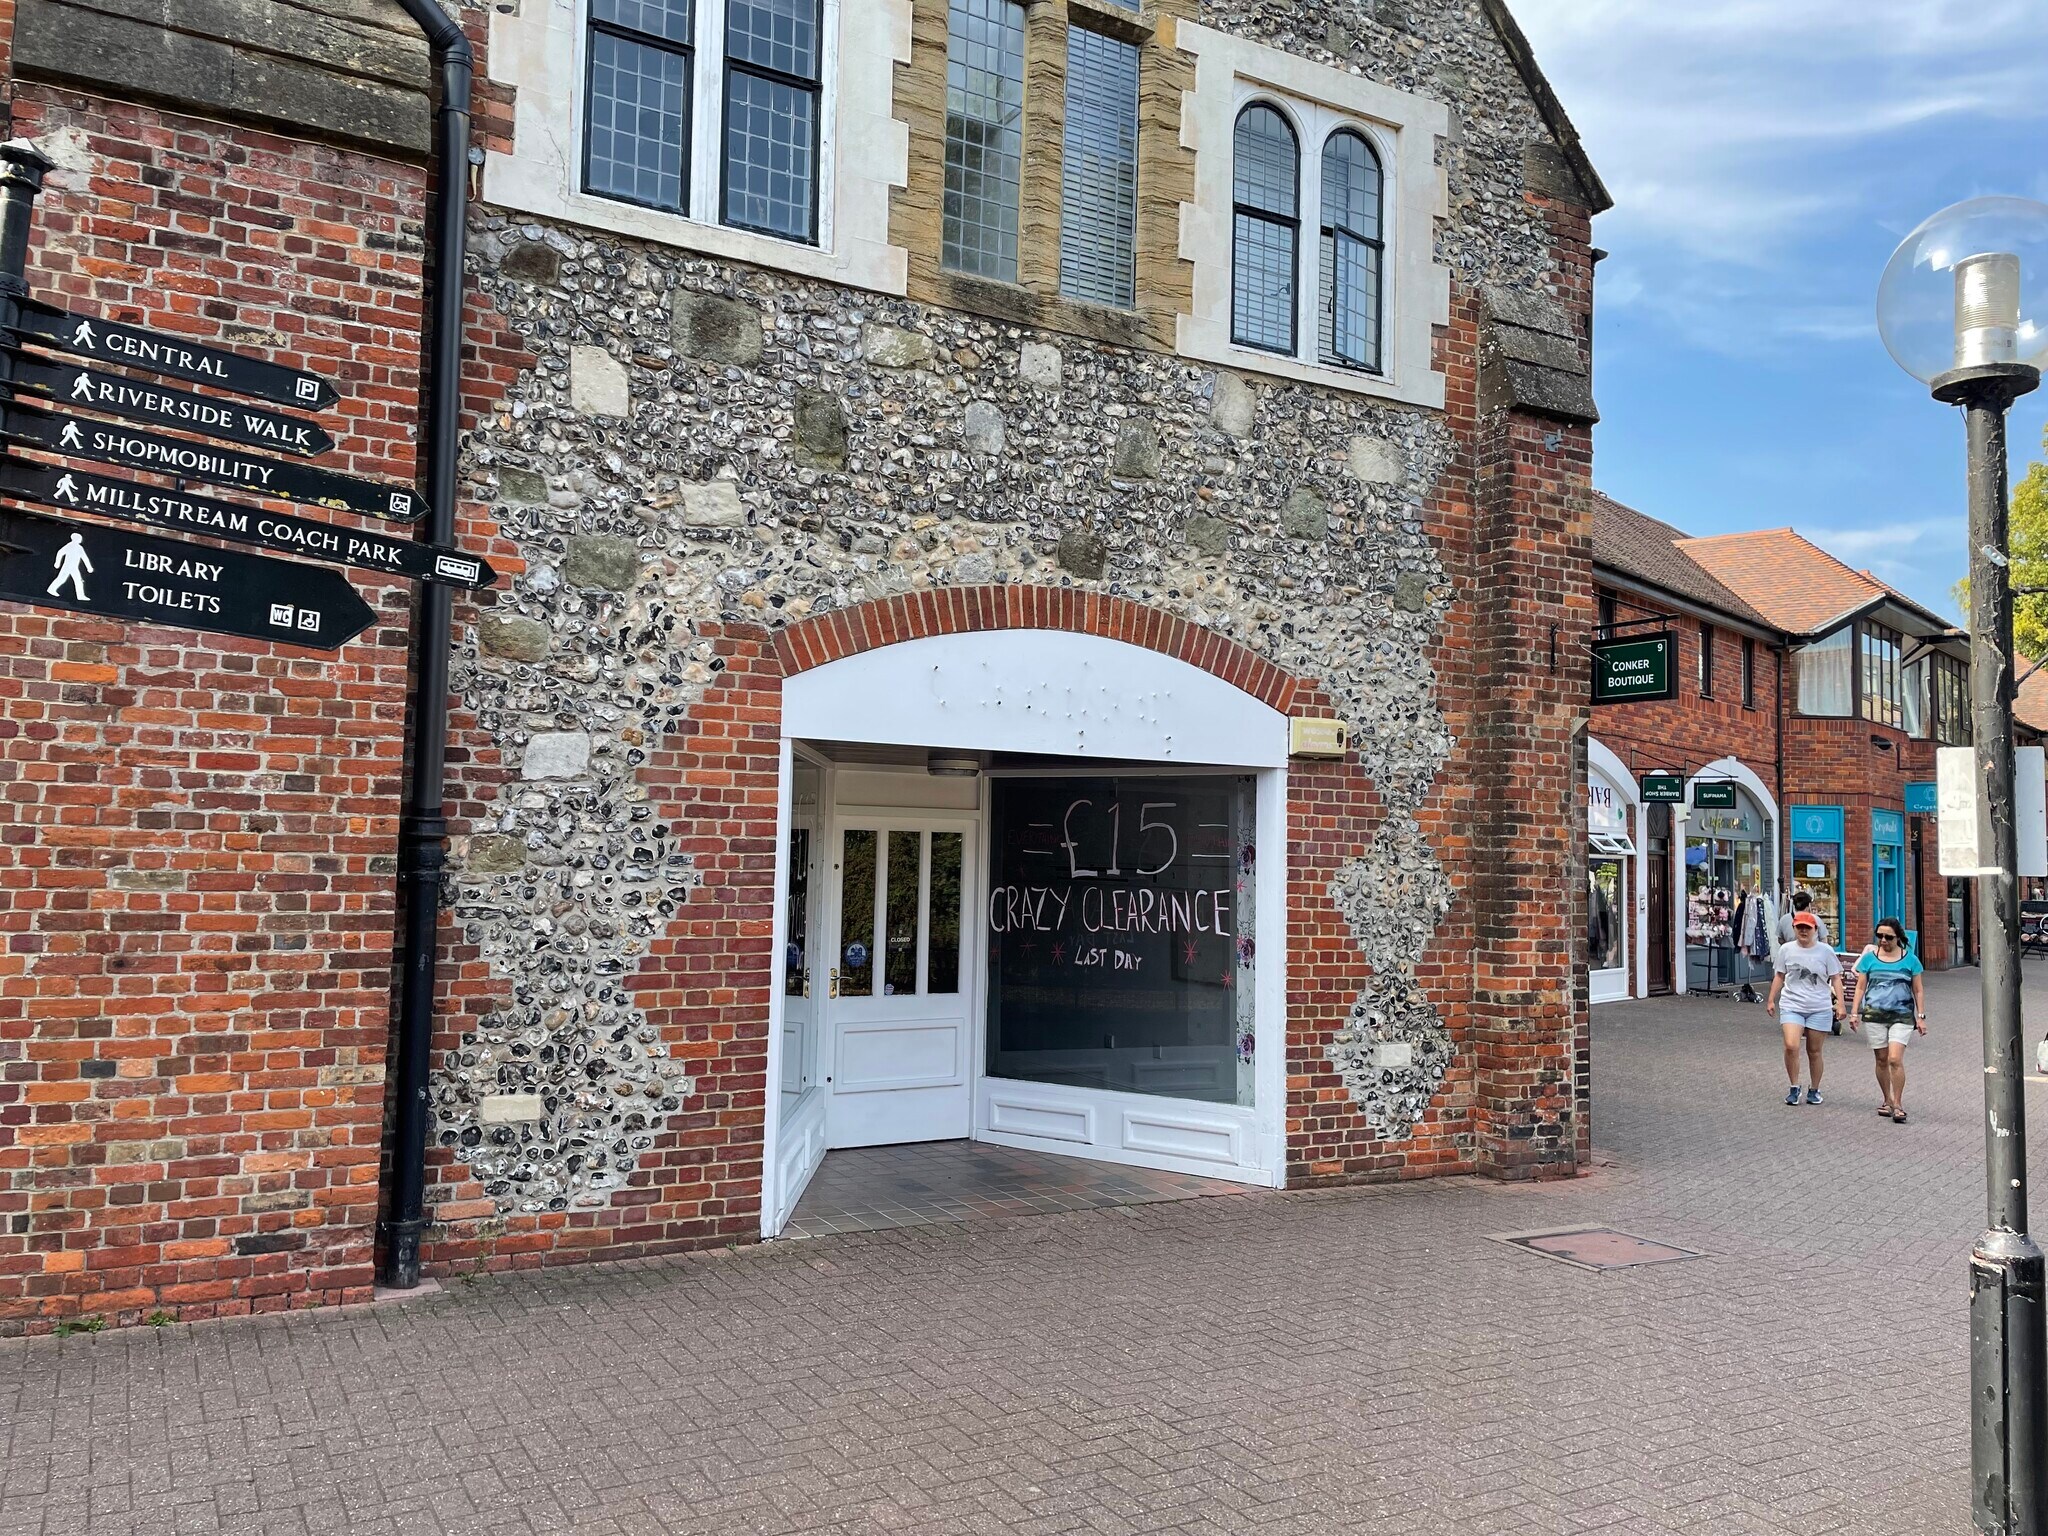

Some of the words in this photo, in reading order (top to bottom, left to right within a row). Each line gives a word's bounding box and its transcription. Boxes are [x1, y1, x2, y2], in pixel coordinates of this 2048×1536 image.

[105, 332, 229, 379] CENTRAL
[300, 381, 314, 396] P
[99, 381, 233, 428] RIVERSIDE
[243, 413, 311, 447] WALK
[92, 431, 274, 485] SHOPMOBILITY
[85, 483, 248, 533] MILLSTREAM
[257, 519, 339, 551] COACH
[348, 538, 402, 565] PARK
[124, 549, 224, 582] LIBRARY
[122, 581, 221, 614] TOILETS
[274, 608, 291, 624] WC
[1657, 643, 1664, 652] 9
[1608, 674, 1654, 688] BOUTIQUE
[1612, 659, 1650, 672] CONKER
[1587, 786, 1611, 808] BAR
[1060, 800, 1177, 878] £15
[989, 885, 1072, 932] CRAZY
[1082, 886, 1231, 937] CLEARANCE
[1074, 945, 1107, 965] LAST
[1114, 950, 1142, 970] DAY
